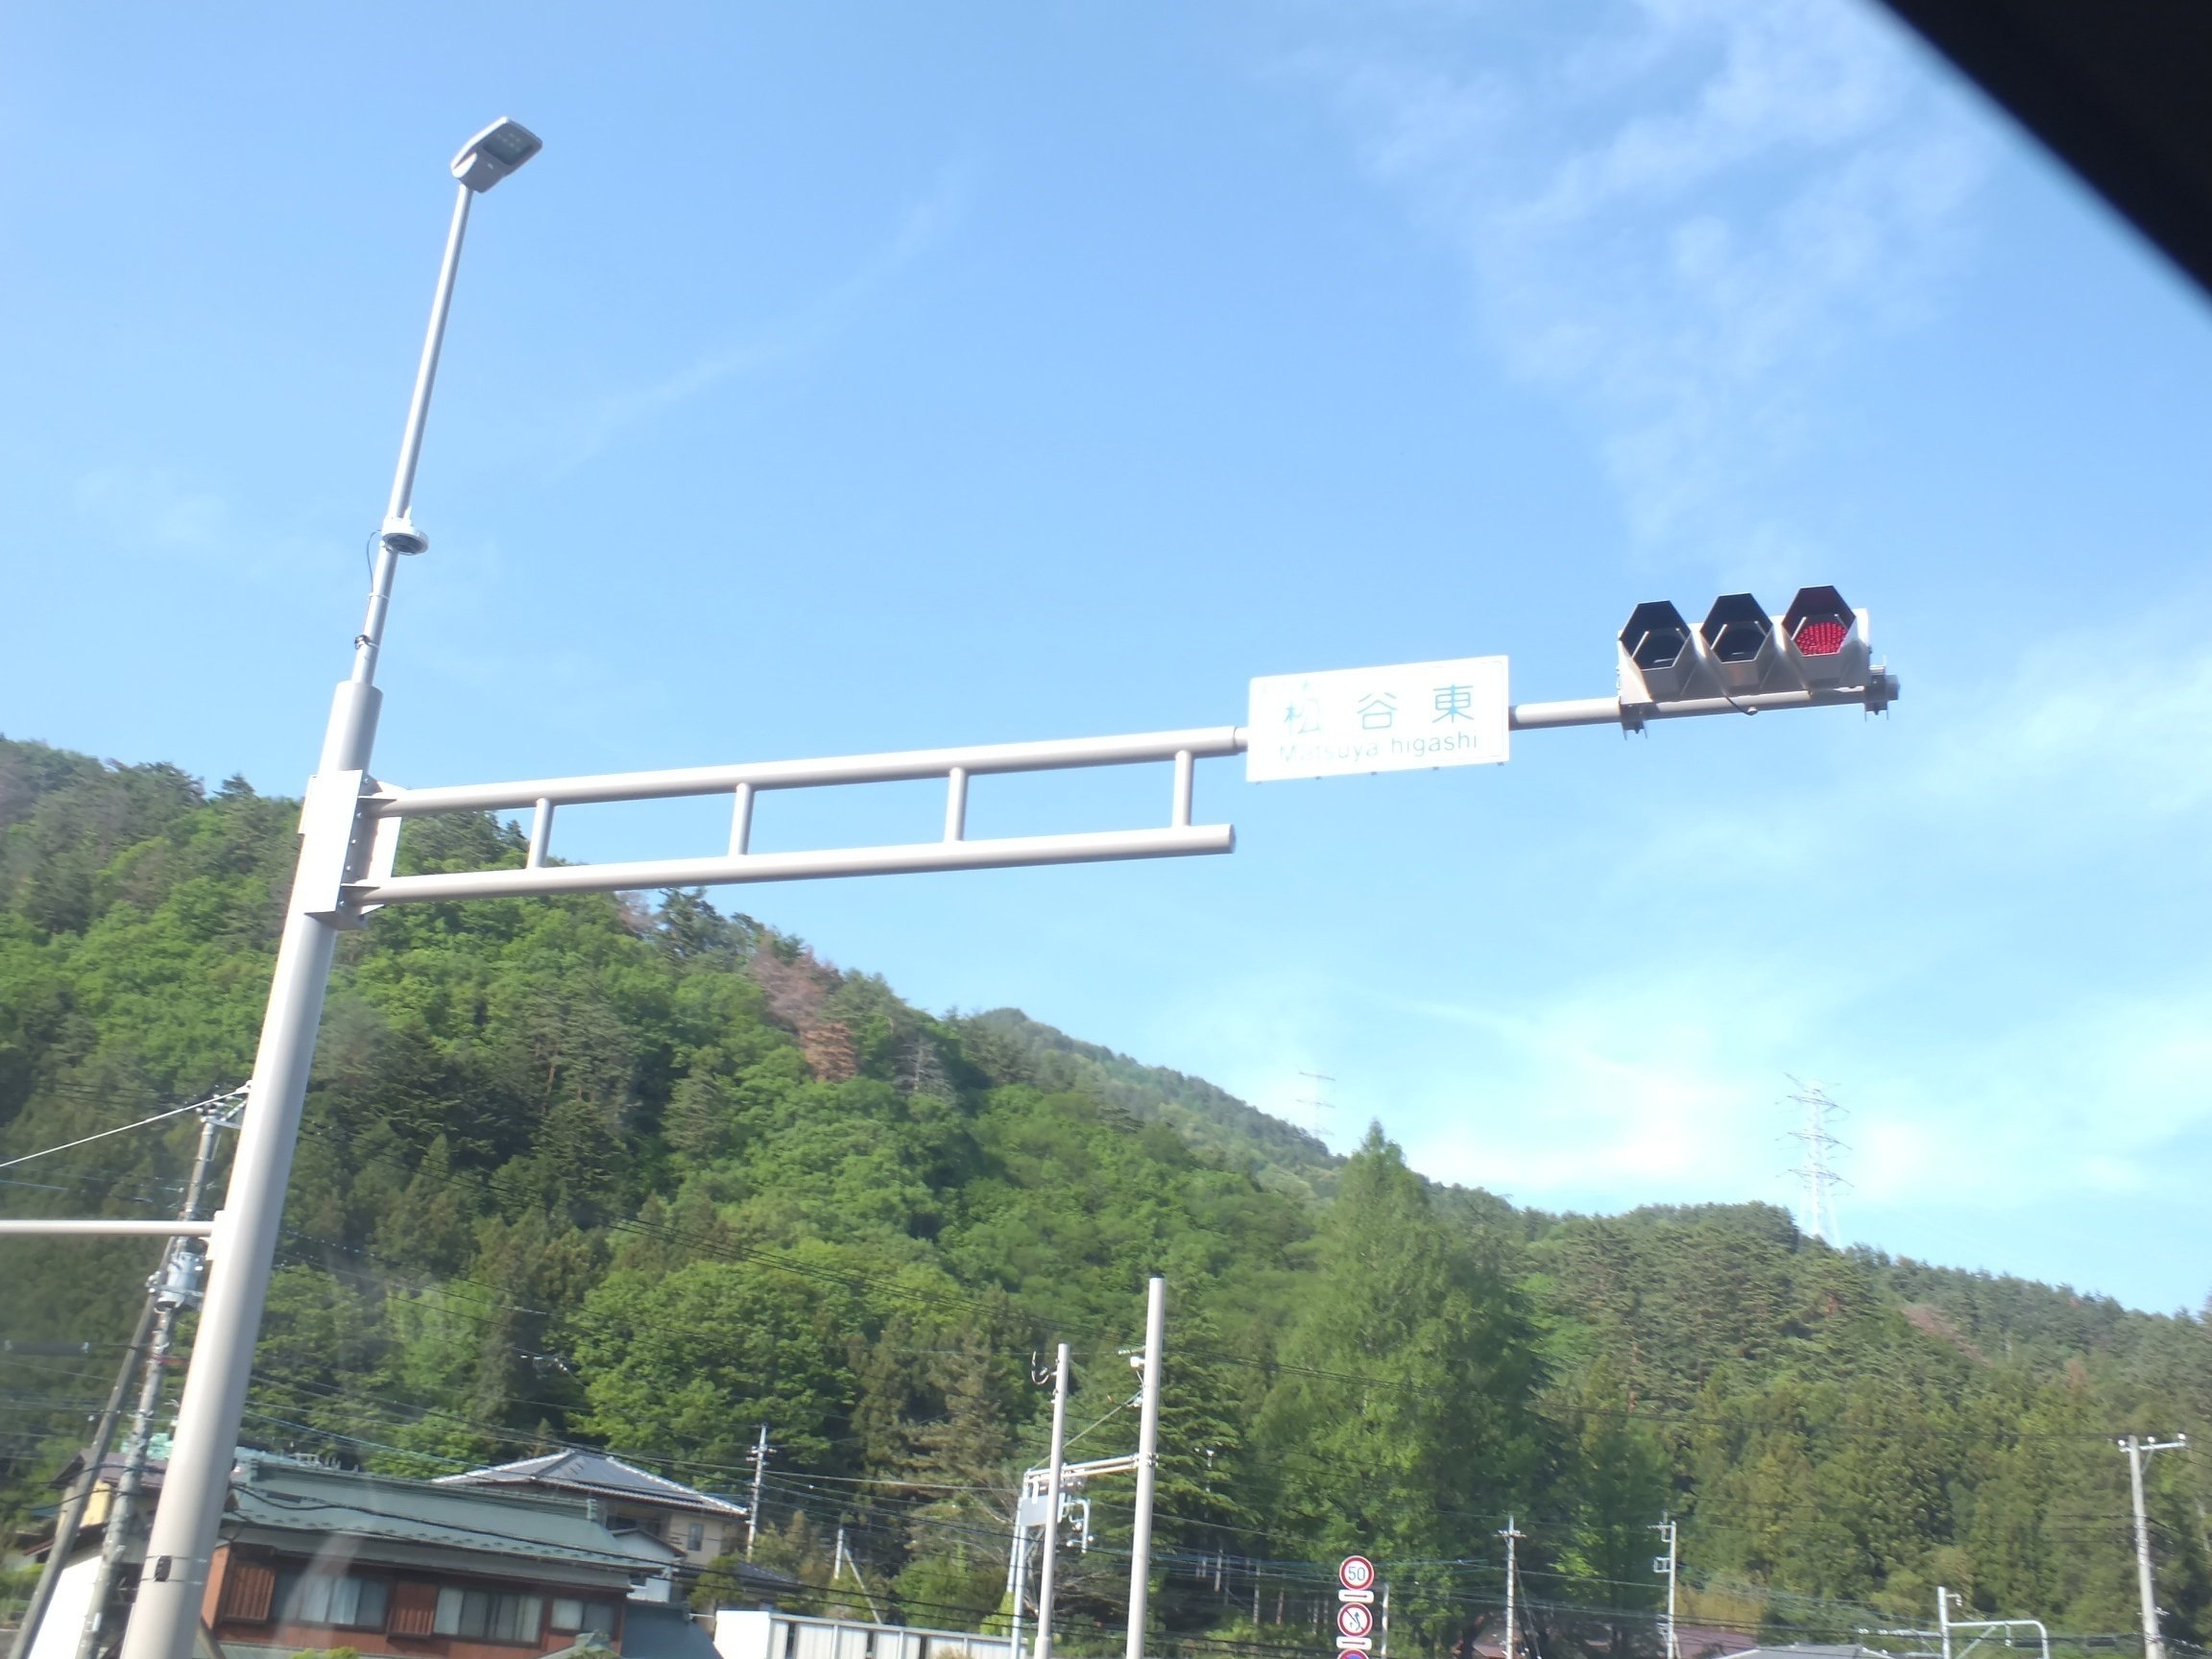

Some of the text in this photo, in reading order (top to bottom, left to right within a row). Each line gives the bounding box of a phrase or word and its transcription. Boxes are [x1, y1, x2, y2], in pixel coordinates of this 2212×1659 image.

[1284, 684, 1475, 737] 松谷東
[1391, 731, 1479, 758] higashi
[1348, 1567, 1366, 1581] 50
